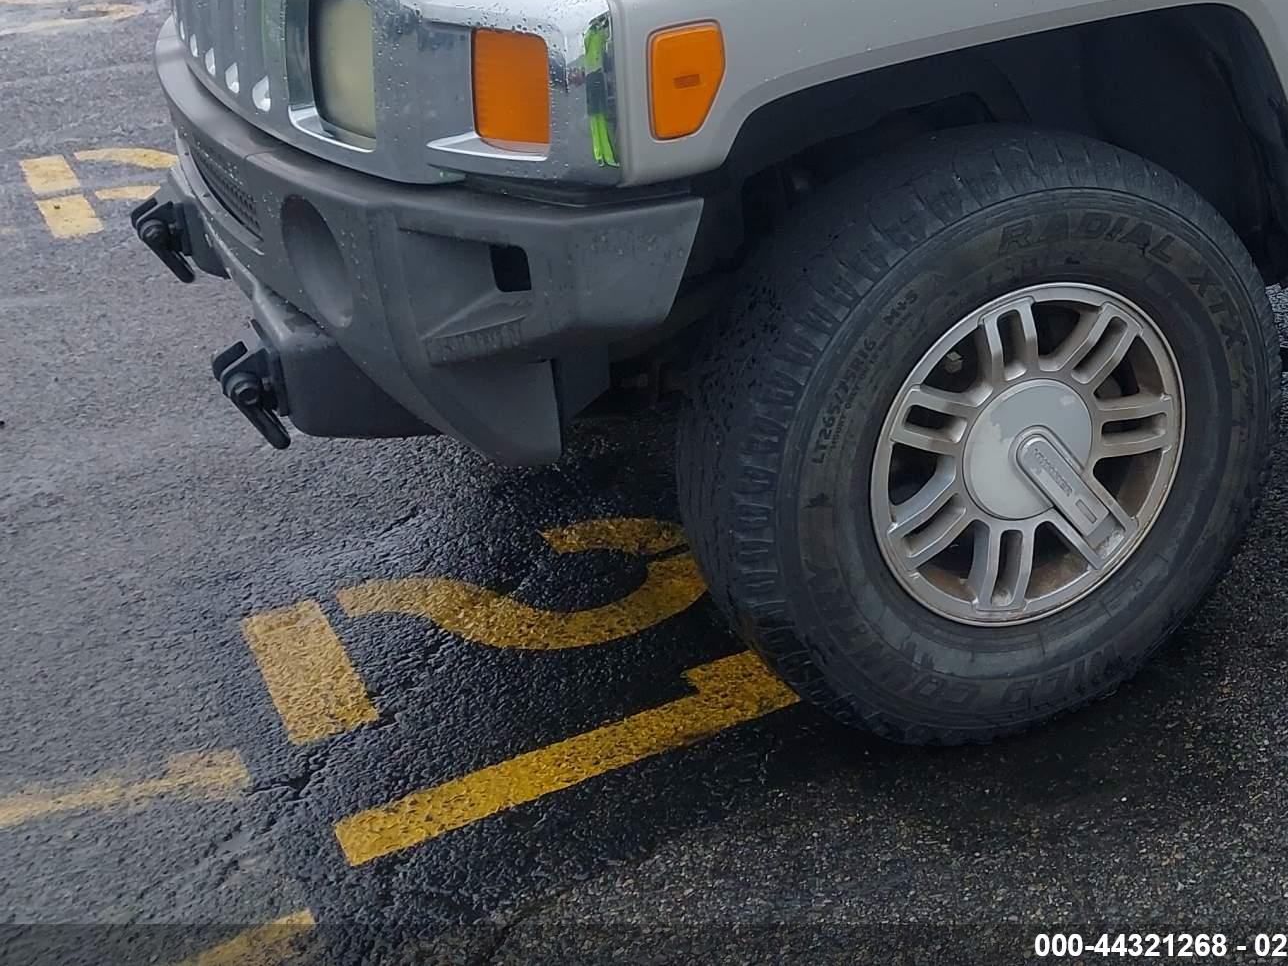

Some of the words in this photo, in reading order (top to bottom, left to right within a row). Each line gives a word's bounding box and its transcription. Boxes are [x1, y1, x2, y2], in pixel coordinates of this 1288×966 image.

[1000, 210, 1173, 266] RADIAL
[884, 289, 919, 326] M+S
[811, 336, 876, 465] LT265/75R16
